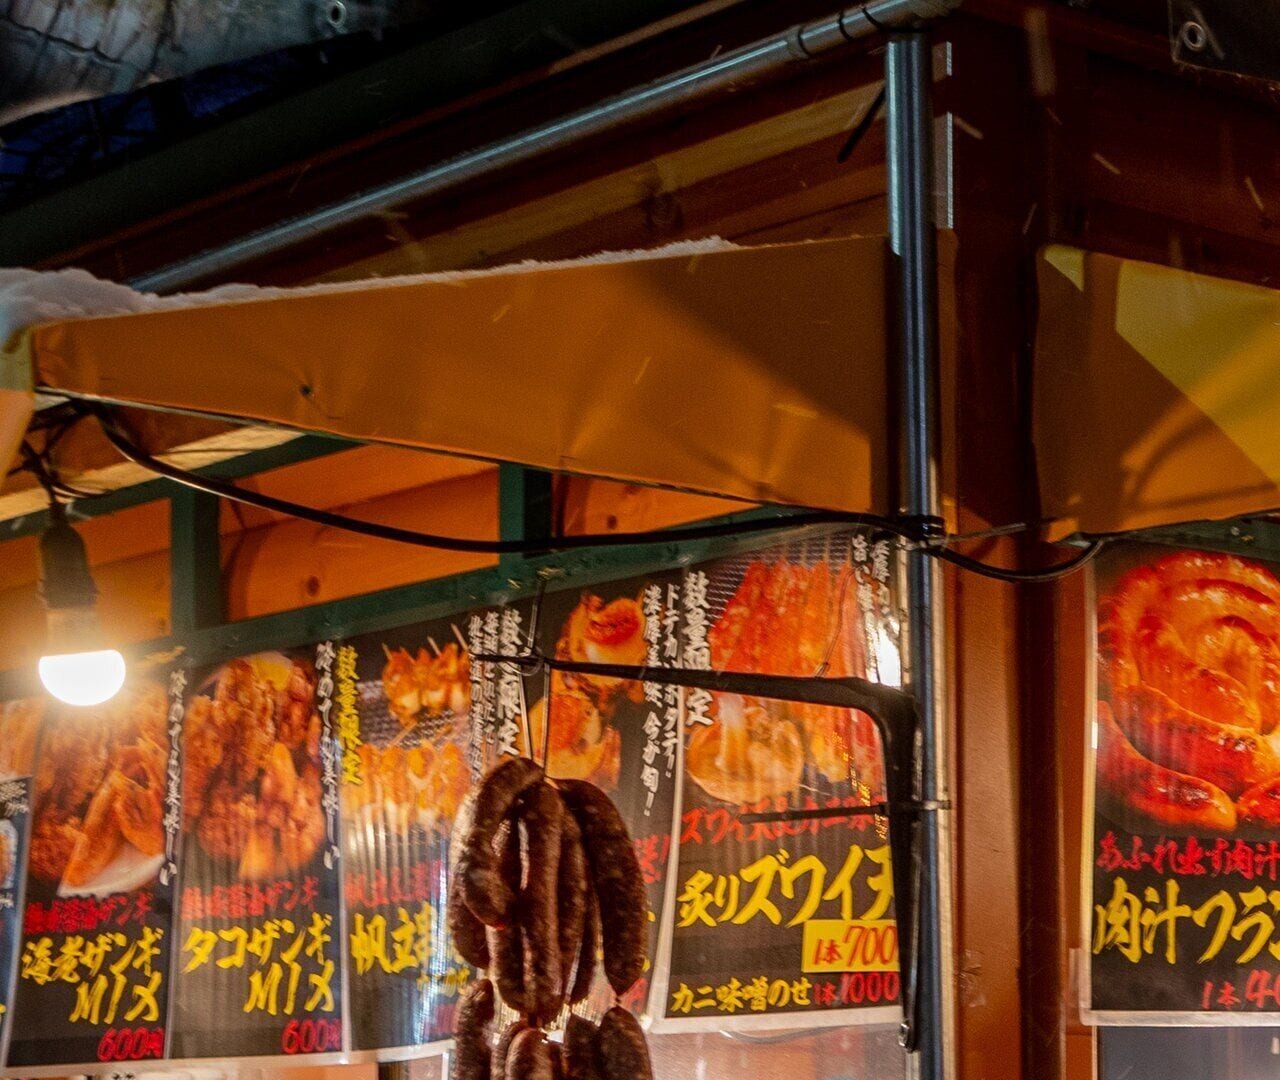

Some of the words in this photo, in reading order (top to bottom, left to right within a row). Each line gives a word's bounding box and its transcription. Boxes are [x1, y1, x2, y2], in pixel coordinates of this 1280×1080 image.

[182, 911, 334, 975] タコザンギ
[68, 971, 163, 1026] MIX
[242, 959, 335, 1016] MIX
